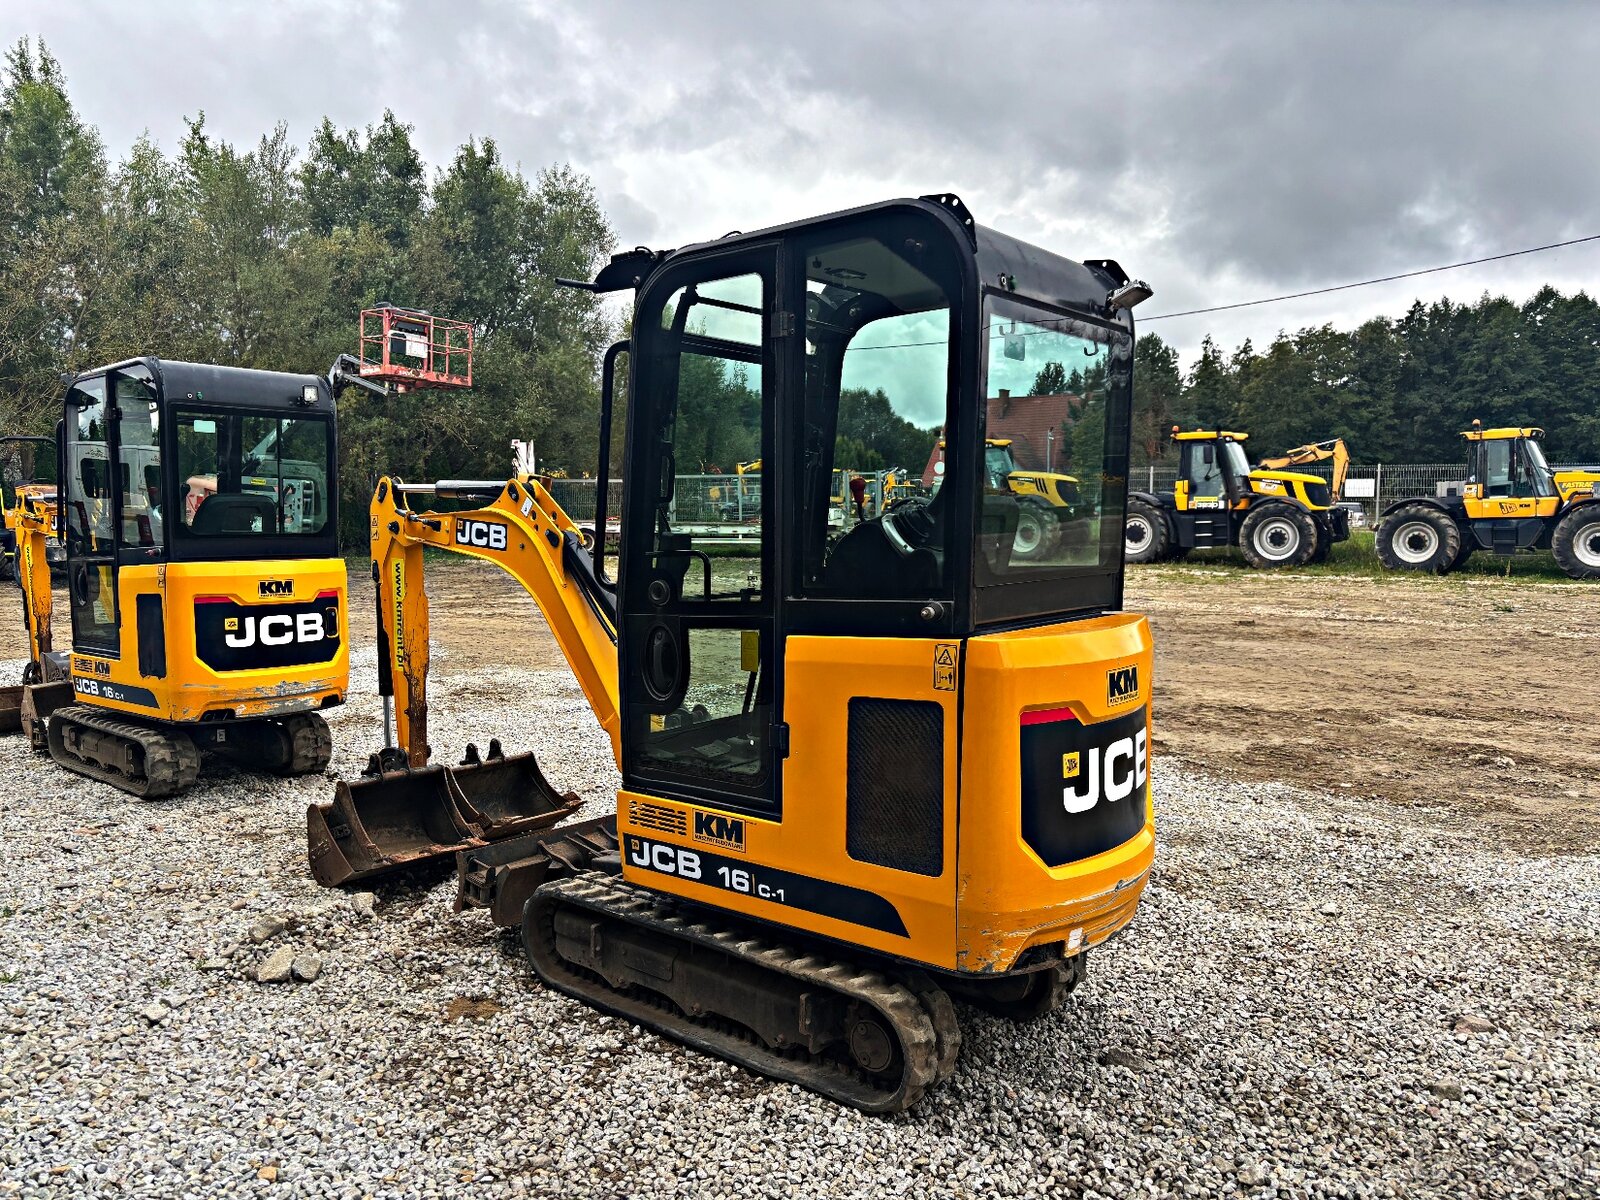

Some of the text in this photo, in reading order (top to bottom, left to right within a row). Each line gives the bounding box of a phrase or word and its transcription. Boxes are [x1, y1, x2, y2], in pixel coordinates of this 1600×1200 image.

[457, 521, 506, 549] JCB
[260, 581, 293, 594] KM
[225, 612, 325, 648] JCB
[76, 678, 99, 695] JCB
[103, 686, 113, 698] 16
[1109, 667, 1138, 698] KM
[1063, 726, 1147, 814] JCB
[694, 811, 743, 844] KM
[631, 841, 702, 880] JCB
[717, 866, 749, 893] 16
